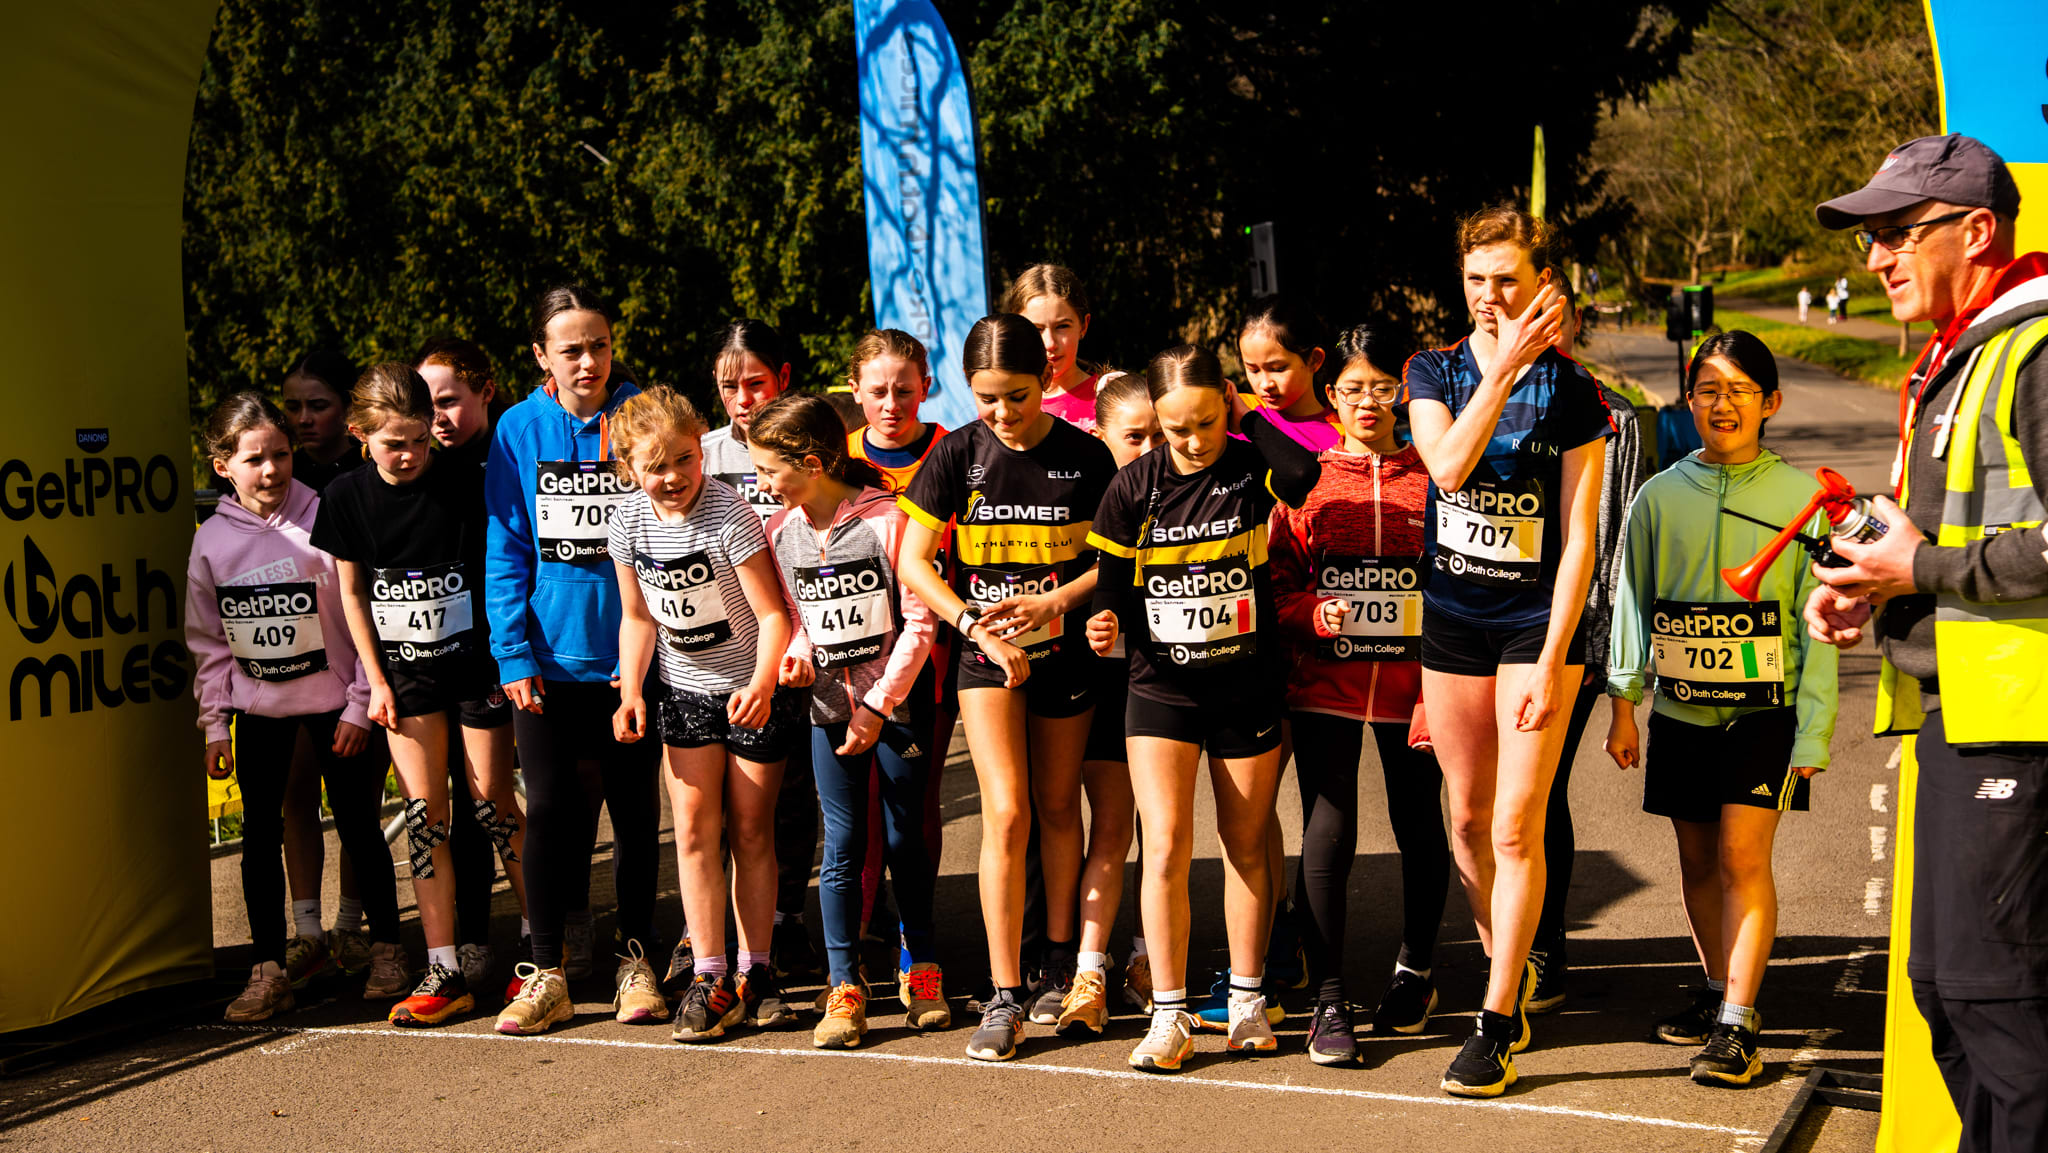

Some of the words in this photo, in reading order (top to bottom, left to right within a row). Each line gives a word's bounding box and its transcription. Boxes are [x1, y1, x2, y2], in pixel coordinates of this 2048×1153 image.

[1512, 438, 1558, 456] RUN
[1048, 470, 1081, 479] ELLA
[0, 454, 178, 521] GetPRO
[541, 510, 548, 520] 3
[978, 505, 1070, 521] SOMER
[1152, 516, 1242, 542] SOMER
[1442, 517, 1448, 528] 3
[1466, 521, 1514, 549] 707
[576, 547, 595, 555] Bath
[975, 540, 1038, 549] ATHLETIC
[635, 560, 709, 589] GetPRO
[1322, 567, 1417, 589] GetPRO
[1467, 564, 1486, 575] Bath
[1487, 568, 1521, 580] College
[373, 572, 463, 600] GetPRO
[796, 570, 879, 600] GetPRO
[1148, 568, 1247, 597] GetPRO
[221, 593, 312, 617] GetPRO
[661, 598, 696, 618] 416
[1351, 601, 1398, 623] 703
[379, 616, 386, 625] 2
[408, 607, 446, 630] 417
[821, 605, 864, 631] 414
[1153, 614, 1160, 625] 3
[1183, 604, 1232, 630] 704
[1654, 612, 1754, 636] GetPRO
[229, 632, 236, 642] 2
[253, 625, 296, 647] 409
[683, 632, 715, 644] College
[416, 649, 432, 658] Bath
[433, 641, 460, 657] College
[829, 652, 848, 661] Bath
[848, 645, 880, 658] College
[1190, 650, 1209, 660] Bath
[1210, 645, 1240, 657] College
[1354, 644, 1373, 653] Bath
[1374, 644, 1405, 654] College
[1658, 649, 1664, 659] 3
[1685, 647, 1733, 669] 702
[263, 666, 278, 675] Bath
[280, 661, 311, 673] College
[1692, 689, 1710, 698] Bath
[1711, 690, 1746, 700] College
